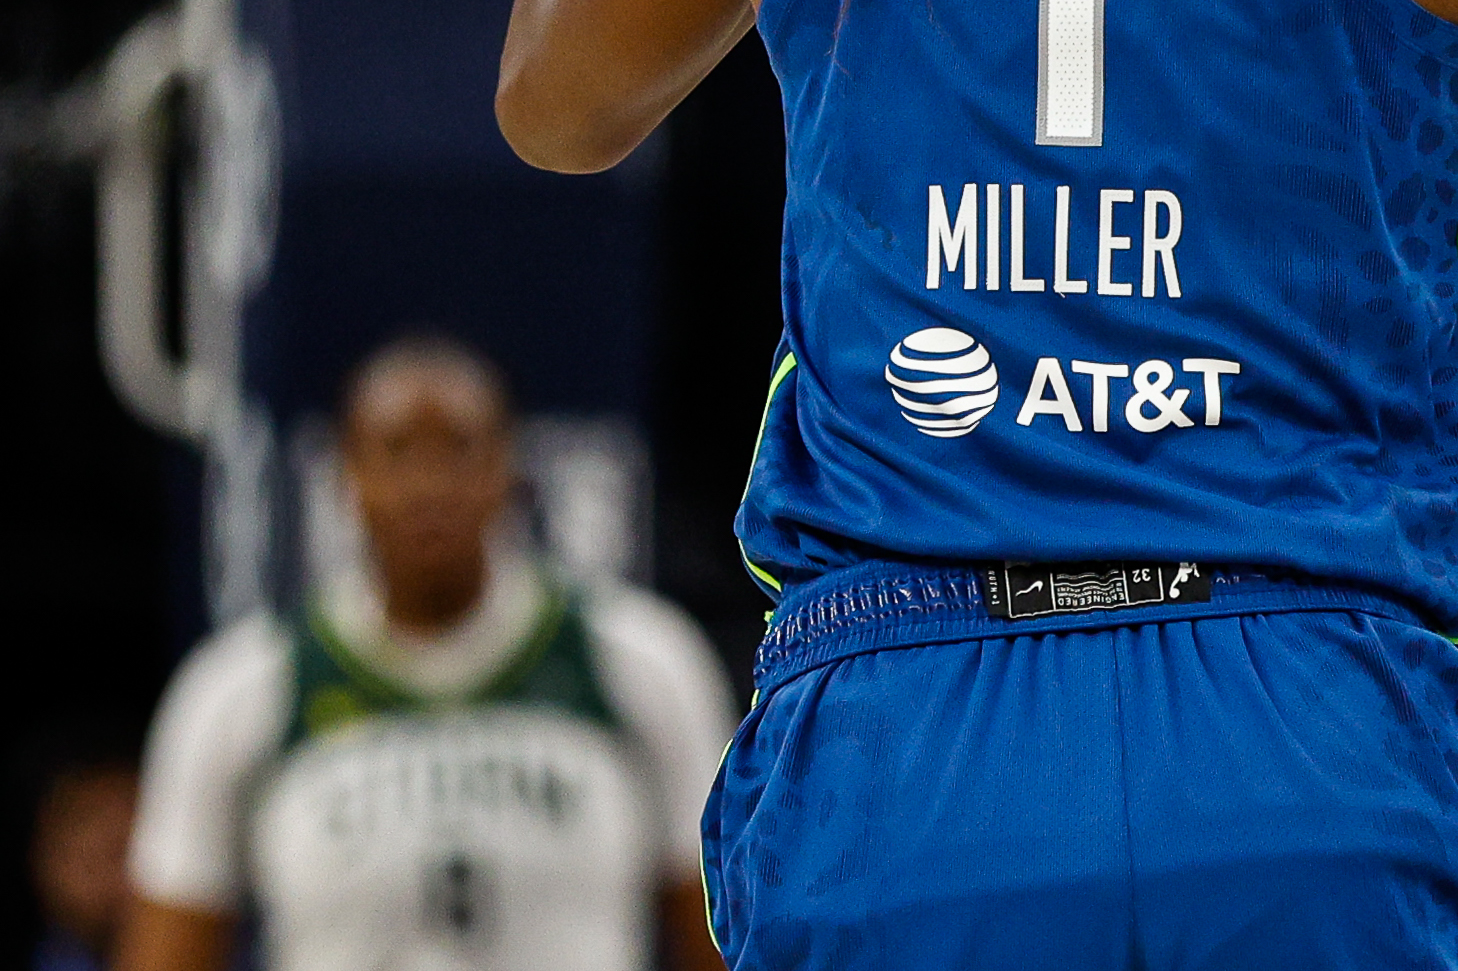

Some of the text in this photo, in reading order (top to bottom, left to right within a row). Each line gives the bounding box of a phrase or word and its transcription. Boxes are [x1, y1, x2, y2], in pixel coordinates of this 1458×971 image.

[925, 182, 1182, 300] MILLER
[1016, 357, 1241, 434] AT&T
[1132, 567, 1152, 584] 32
[1056, 592, 1125, 607] ENGINEERED
